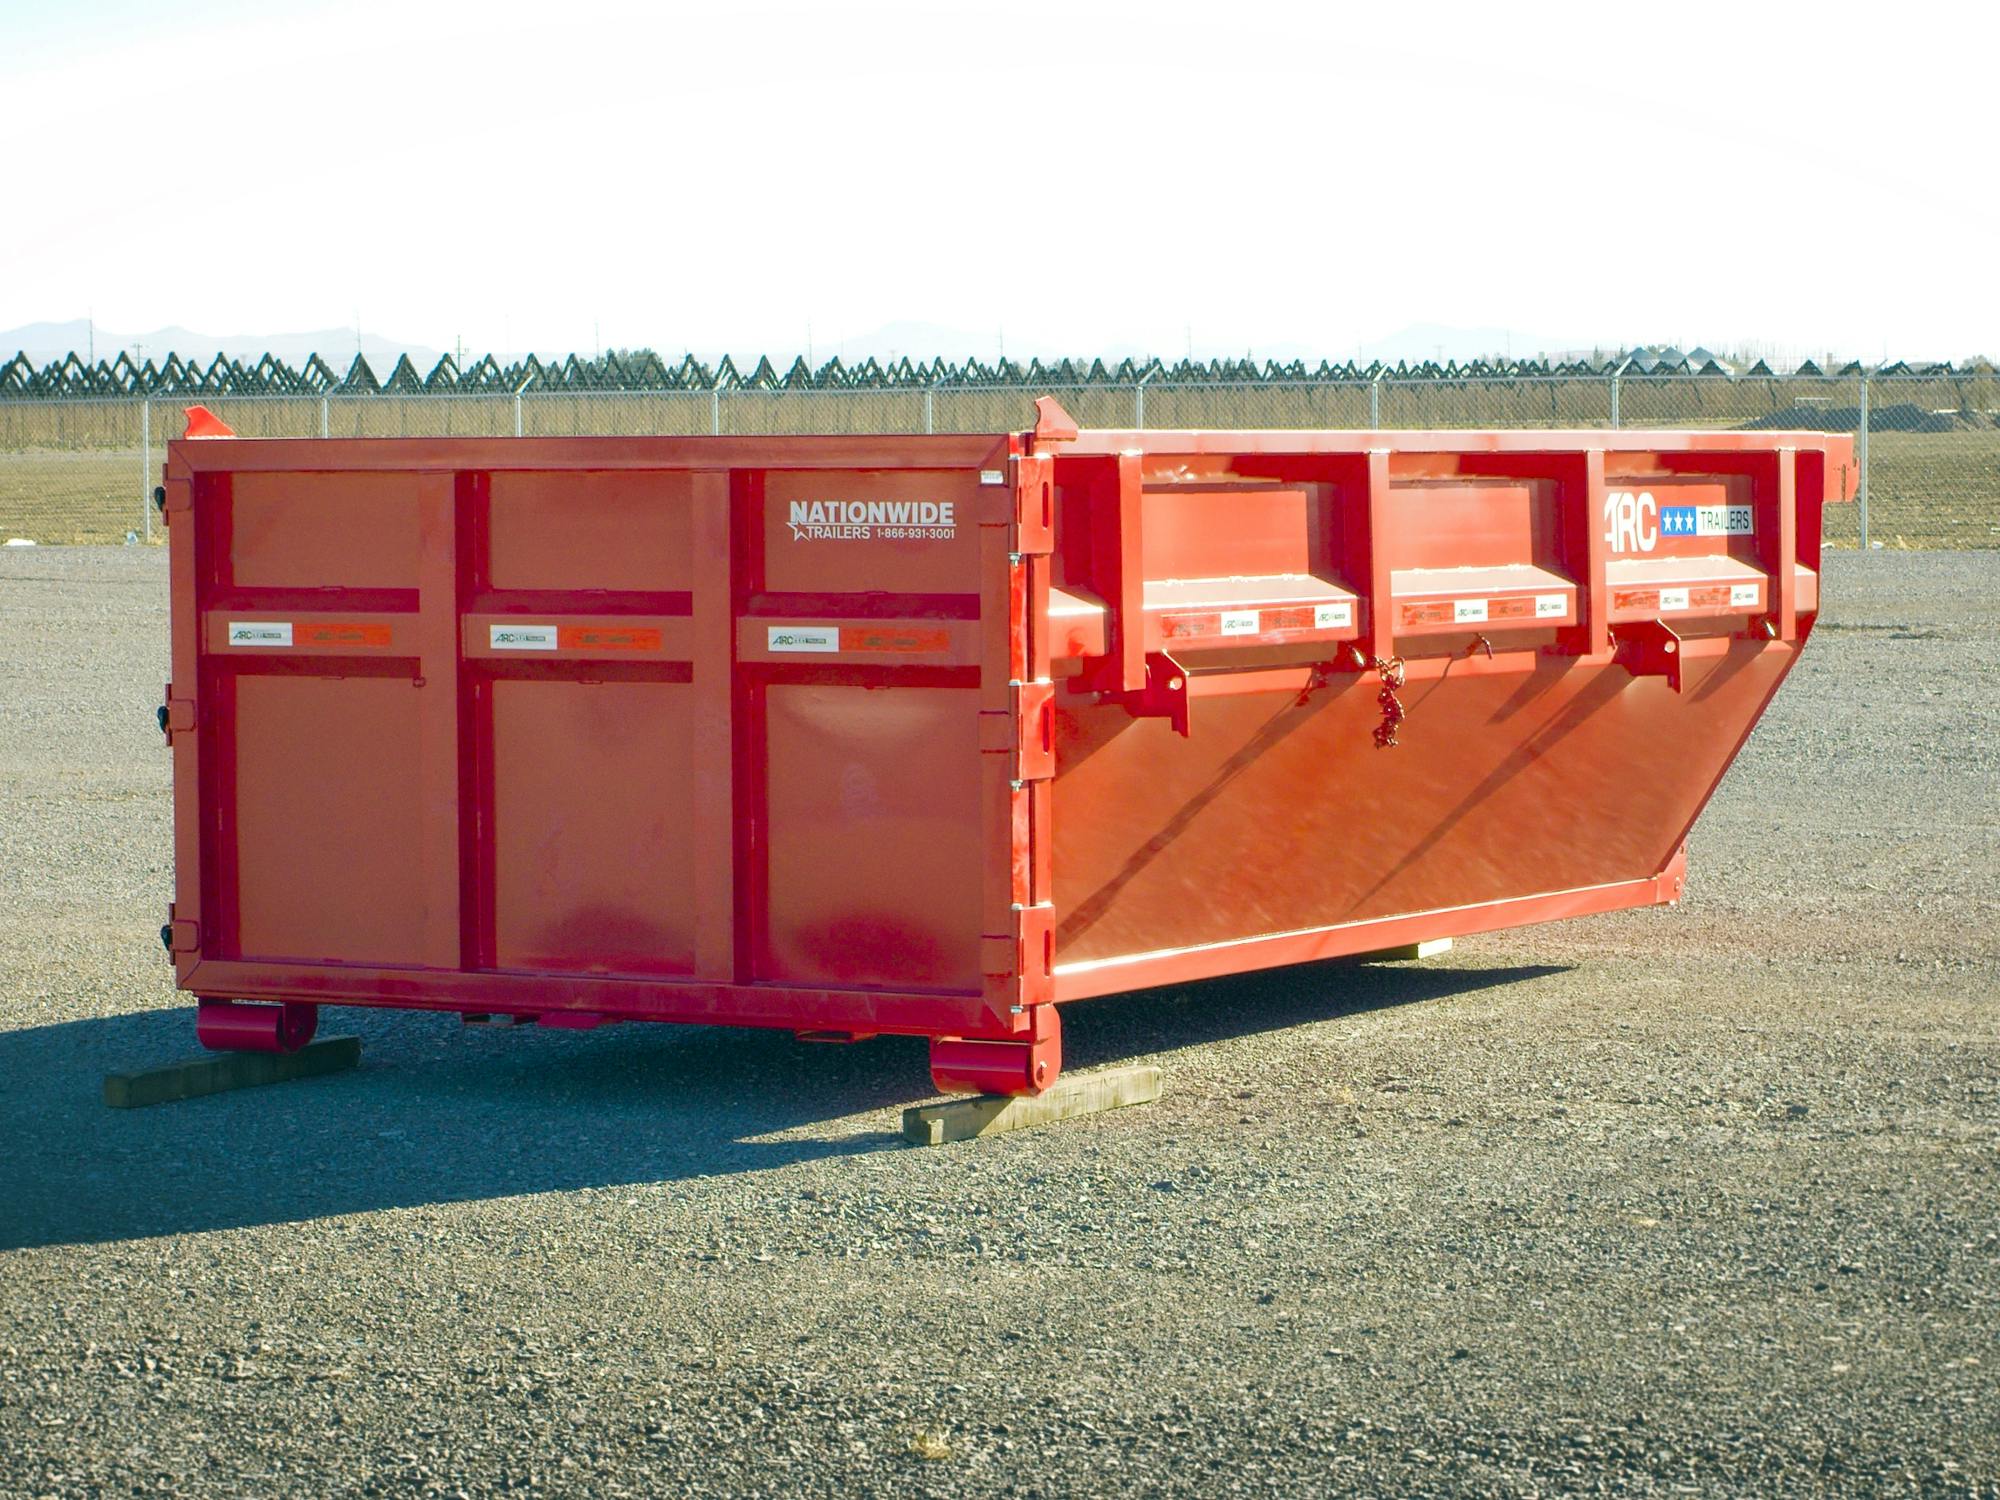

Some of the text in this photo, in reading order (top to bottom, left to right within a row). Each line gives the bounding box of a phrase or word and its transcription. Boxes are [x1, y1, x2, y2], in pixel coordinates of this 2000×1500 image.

[790, 501, 954, 524] NATIONWIDE
[1700, 510, 1750, 530] TRAILERS
[806, 526, 955, 540] TRAILERS 1-866-931-3001
